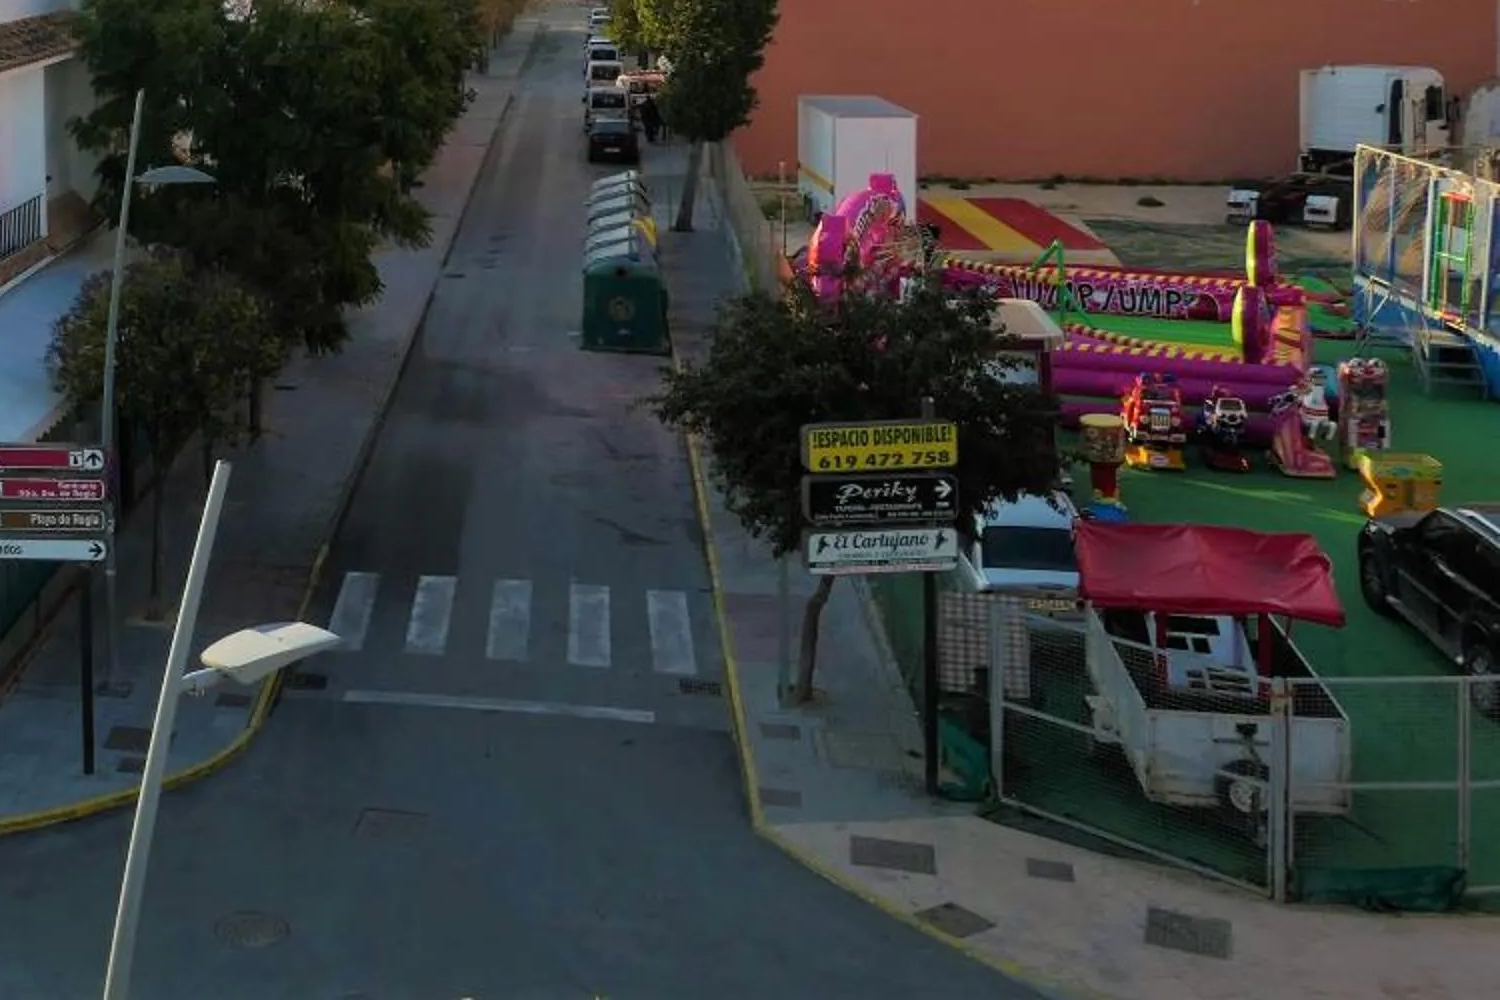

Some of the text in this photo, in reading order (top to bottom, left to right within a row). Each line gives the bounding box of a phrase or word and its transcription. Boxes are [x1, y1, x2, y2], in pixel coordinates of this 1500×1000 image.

[819, 450, 951, 469] 619 472 758
[57, 512, 71, 525] de
